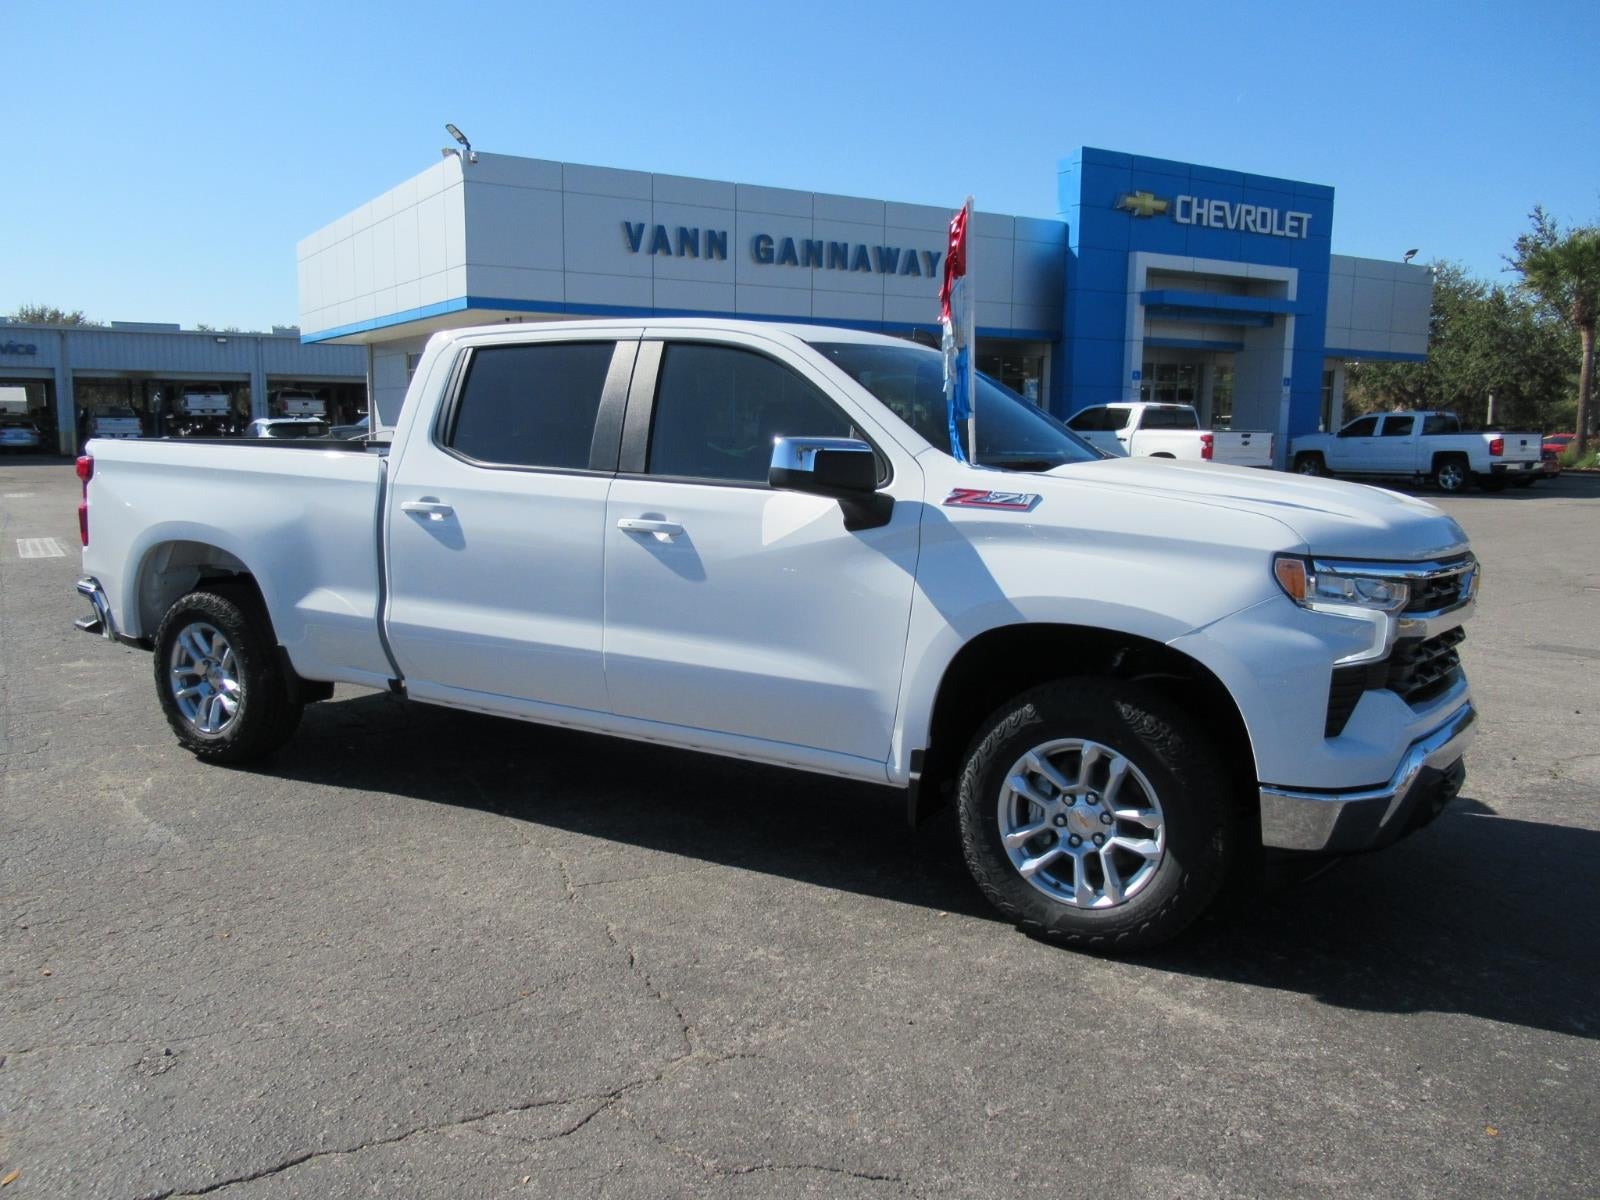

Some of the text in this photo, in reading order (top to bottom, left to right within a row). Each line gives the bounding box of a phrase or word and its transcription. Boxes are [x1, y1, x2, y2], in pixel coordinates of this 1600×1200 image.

[1175, 194, 1312, 239] CHEVROLET
[622, 221, 942, 278] VANN GANNAWAY
[942, 487, 1042, 512] Z71
